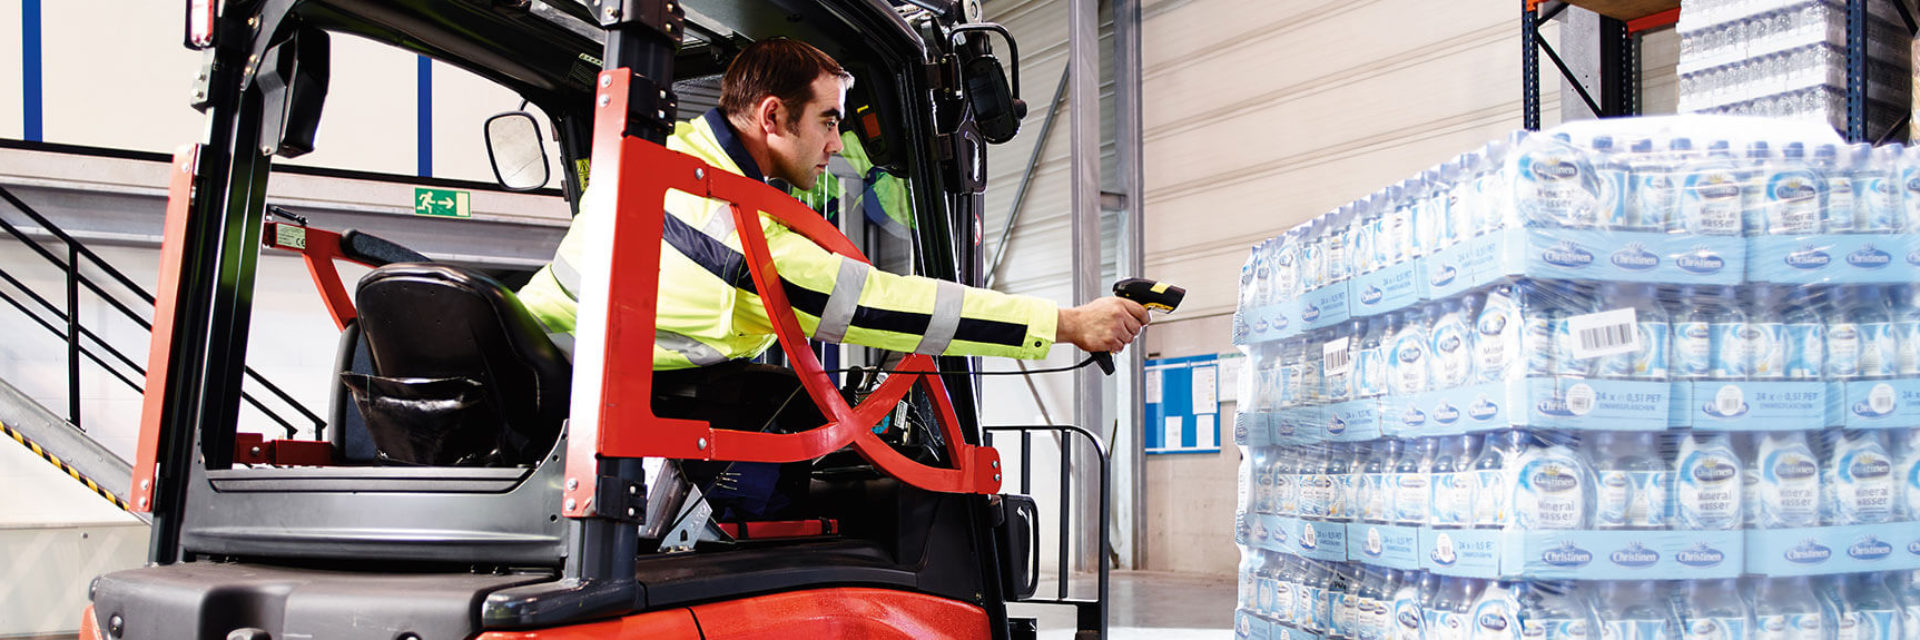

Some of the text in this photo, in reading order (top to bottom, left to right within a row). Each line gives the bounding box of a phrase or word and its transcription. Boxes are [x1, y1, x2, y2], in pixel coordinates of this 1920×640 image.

[1613, 254, 1656, 265] Christinen
[1645, 393, 1662, 403] PET
[1802, 392, 1819, 401] PET
[1545, 551, 1590, 562] Christinen
[1613, 551, 1656, 561] Christinen
[1679, 551, 1721, 561] Christinen
